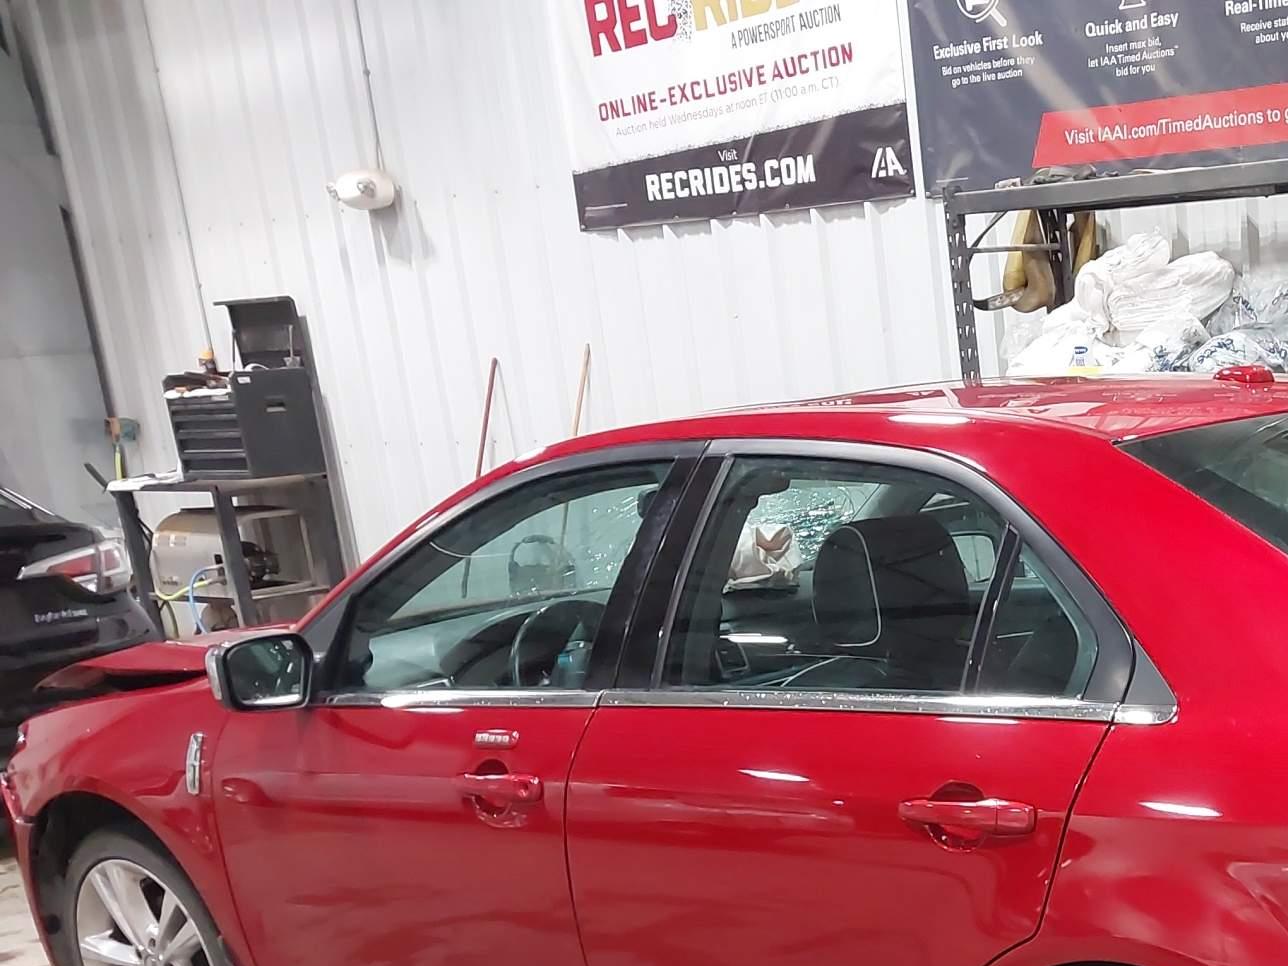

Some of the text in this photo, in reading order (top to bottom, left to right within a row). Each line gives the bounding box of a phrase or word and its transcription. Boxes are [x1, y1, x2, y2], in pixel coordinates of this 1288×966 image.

[730, 31, 738, 49] A
[738, 15, 796, 48] POWERSPORT
[798, 3, 842, 31] AUCTION
[1085, 12, 1179, 37] Quick and Easy
[1240, 19, 1272, 33] Receive
[933, 30, 1043, 60] Exclusive First Look
[1105, 43, 1128, 54] Insert
[1129, 40, 1146, 50] max
[1255, 30, 1279, 44] about
[941, 55, 1036, 76] Bid on vehicles before they
[1087, 57, 1098, 68] let
[1100, 56, 1117, 67] IAA
[1117, 51, 1140, 65] Timed
[1115, 63, 1156, 77] bid for you
[598, 42, 853, 122] ONLINE-EXCLUSIVE AUCTION
[951, 68, 1023, 89] go to the live auction
[615, 122, 648, 137] Auction
[649, 115, 667, 129] held
[668, 106, 723, 126] Wednesdays
[725, 102, 735, 113] at
[735, 97, 757, 111] noon
[1064, 127, 1095, 146] Visit
[1097, 109, 1264, 142] IAAI.com/TimedAuctions
[1266, 109, 1281, 122] to
[717, 149, 738, 163] Visit
[645, 153, 817, 202] RECRIDES.COM
